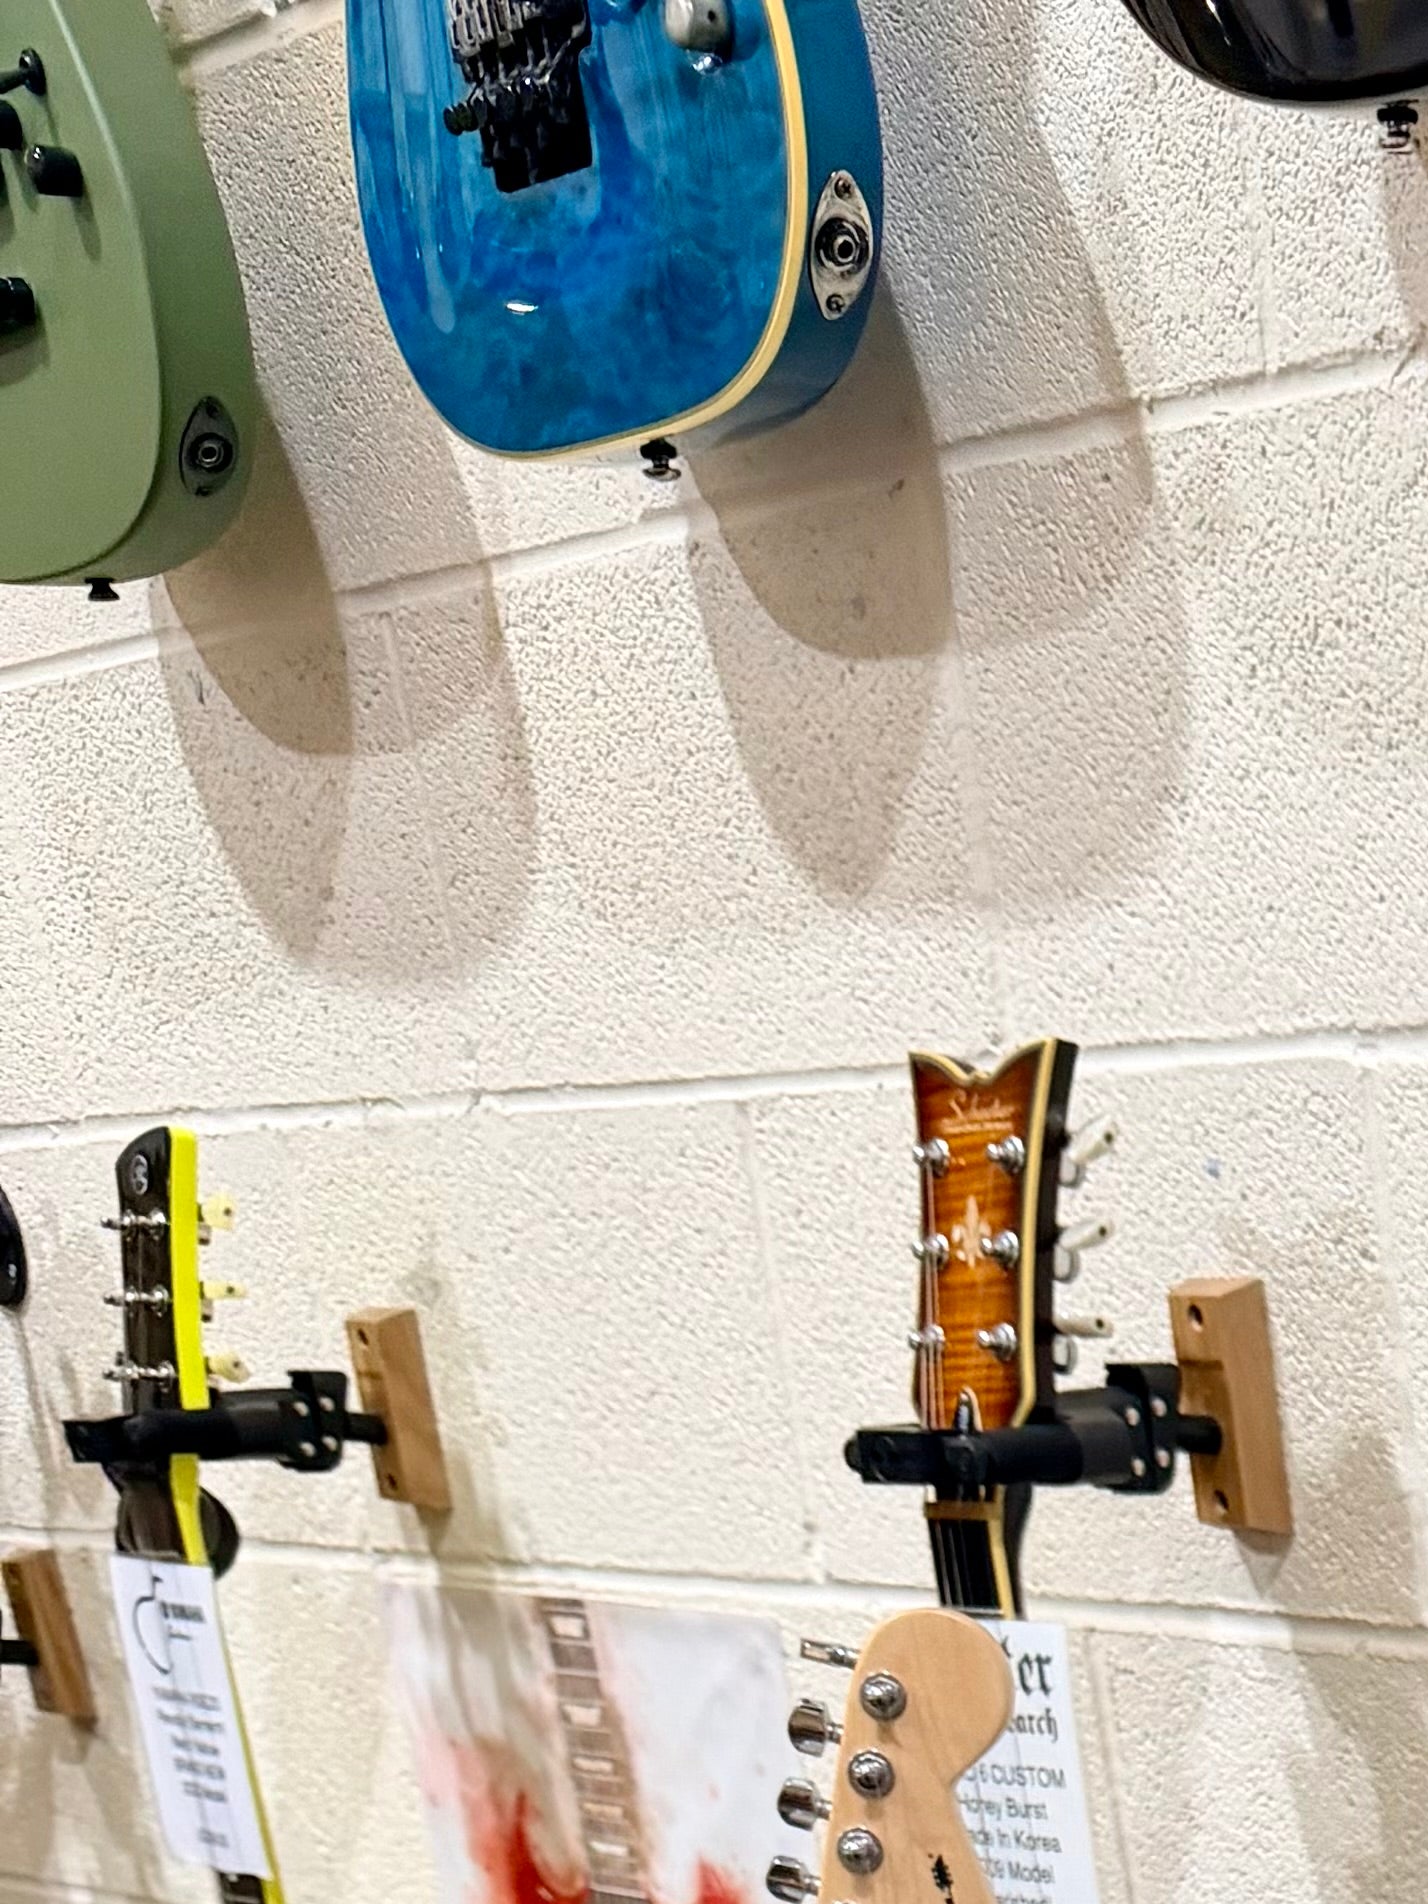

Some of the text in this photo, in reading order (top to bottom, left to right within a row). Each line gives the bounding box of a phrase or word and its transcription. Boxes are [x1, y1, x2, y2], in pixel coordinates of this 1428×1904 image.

[991, 1764, 1066, 1789] CUSTOM
[1006, 1796, 1048, 1820] Burst
[1013, 1828, 1062, 1854] Korea
[1007, 1861, 1056, 1885] Model
